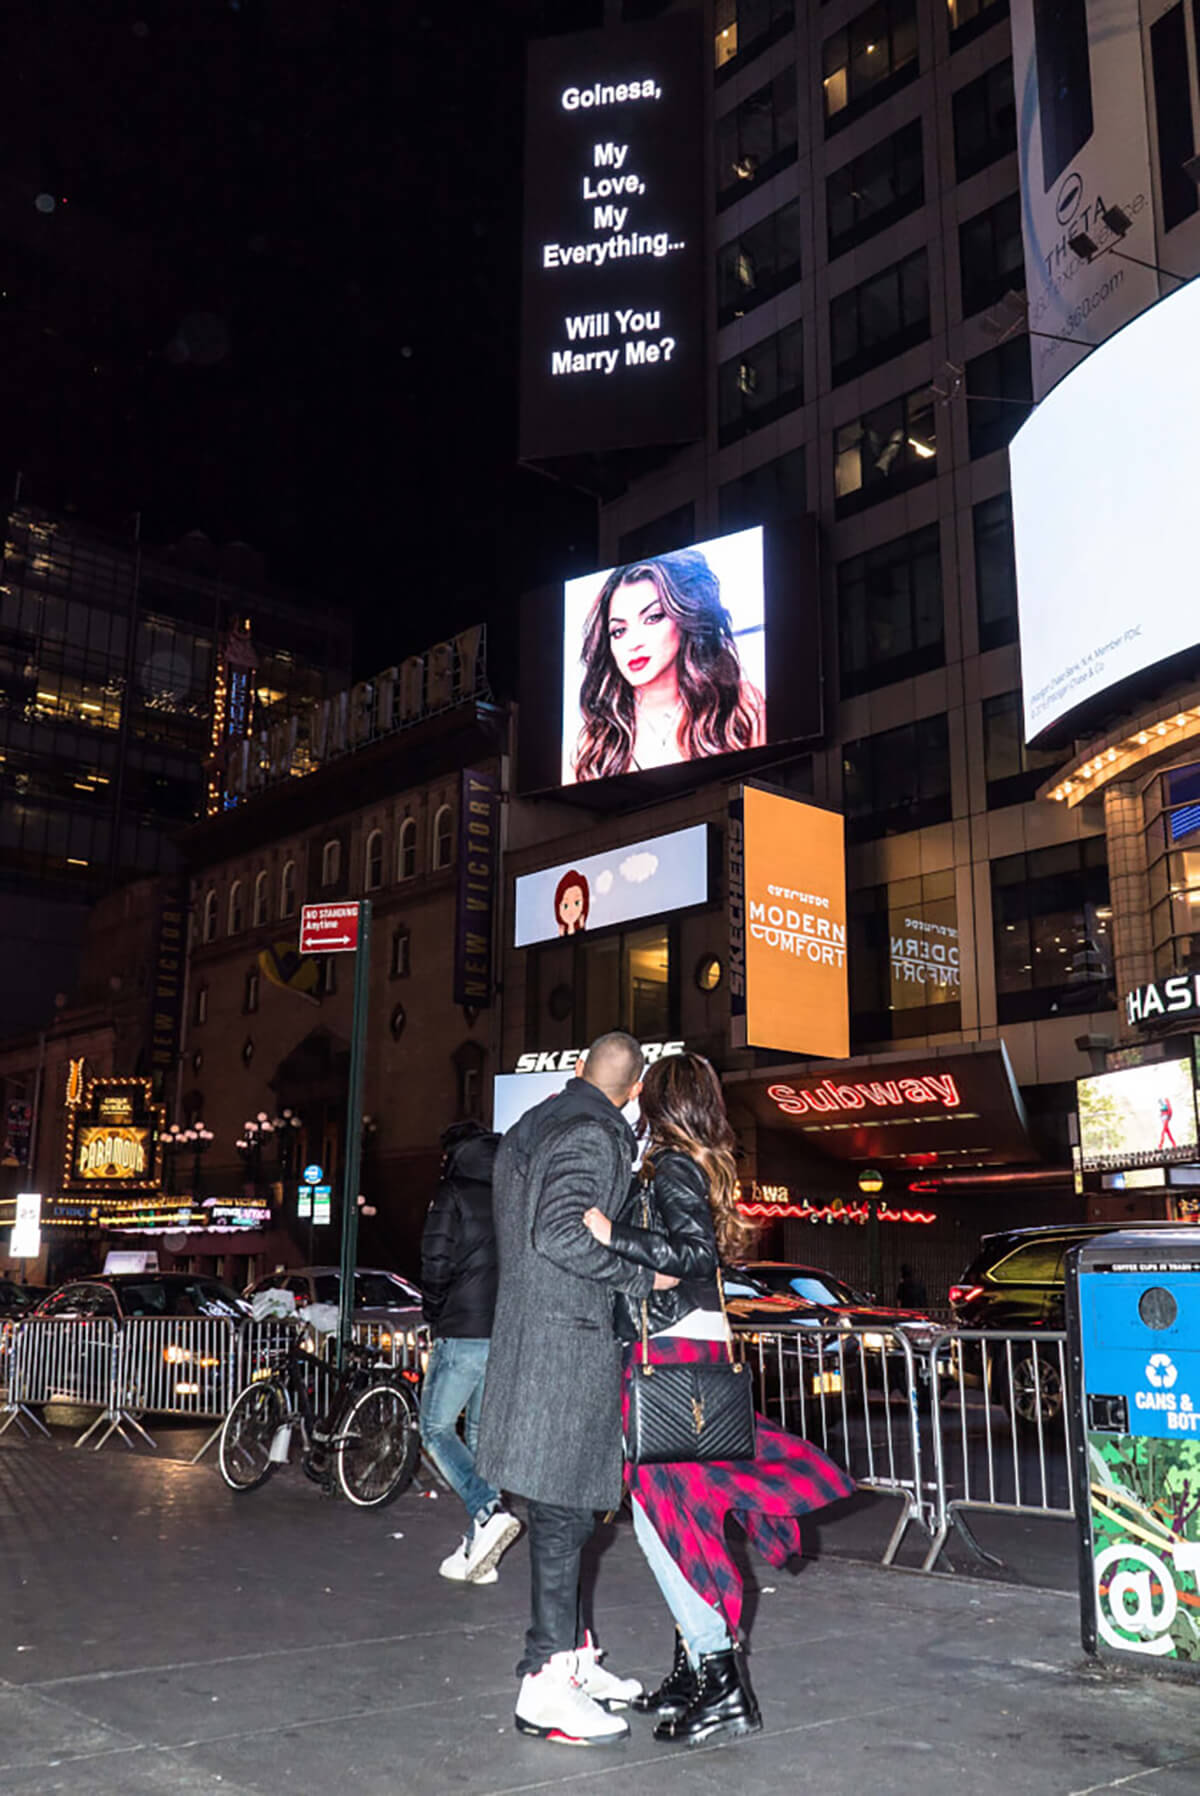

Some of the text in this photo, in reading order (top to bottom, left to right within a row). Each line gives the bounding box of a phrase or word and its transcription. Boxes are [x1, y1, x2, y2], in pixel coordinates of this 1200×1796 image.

[561, 79, 662, 111] Golnesa,
[593, 142, 629, 169] My
[583, 174, 646, 200] Love,
[593, 205, 629, 232] My
[543, 232, 686, 268] Everything...
[565, 308, 661, 341] Will You
[551, 337, 676, 376] Marry Me?
[464, 778, 493, 998] NEW VICTORY
[306, 907, 359, 920] NO STANDING
[749, 900, 845, 943] MODERN
[751, 923, 847, 969] COMFORT
[515, 1041, 686, 1073] SKERS
[767, 1074, 961, 1115] Subway
[79, 1137, 144, 1172] PARAMOUR
[1135, 1391, 1193, 1412] CANS &
